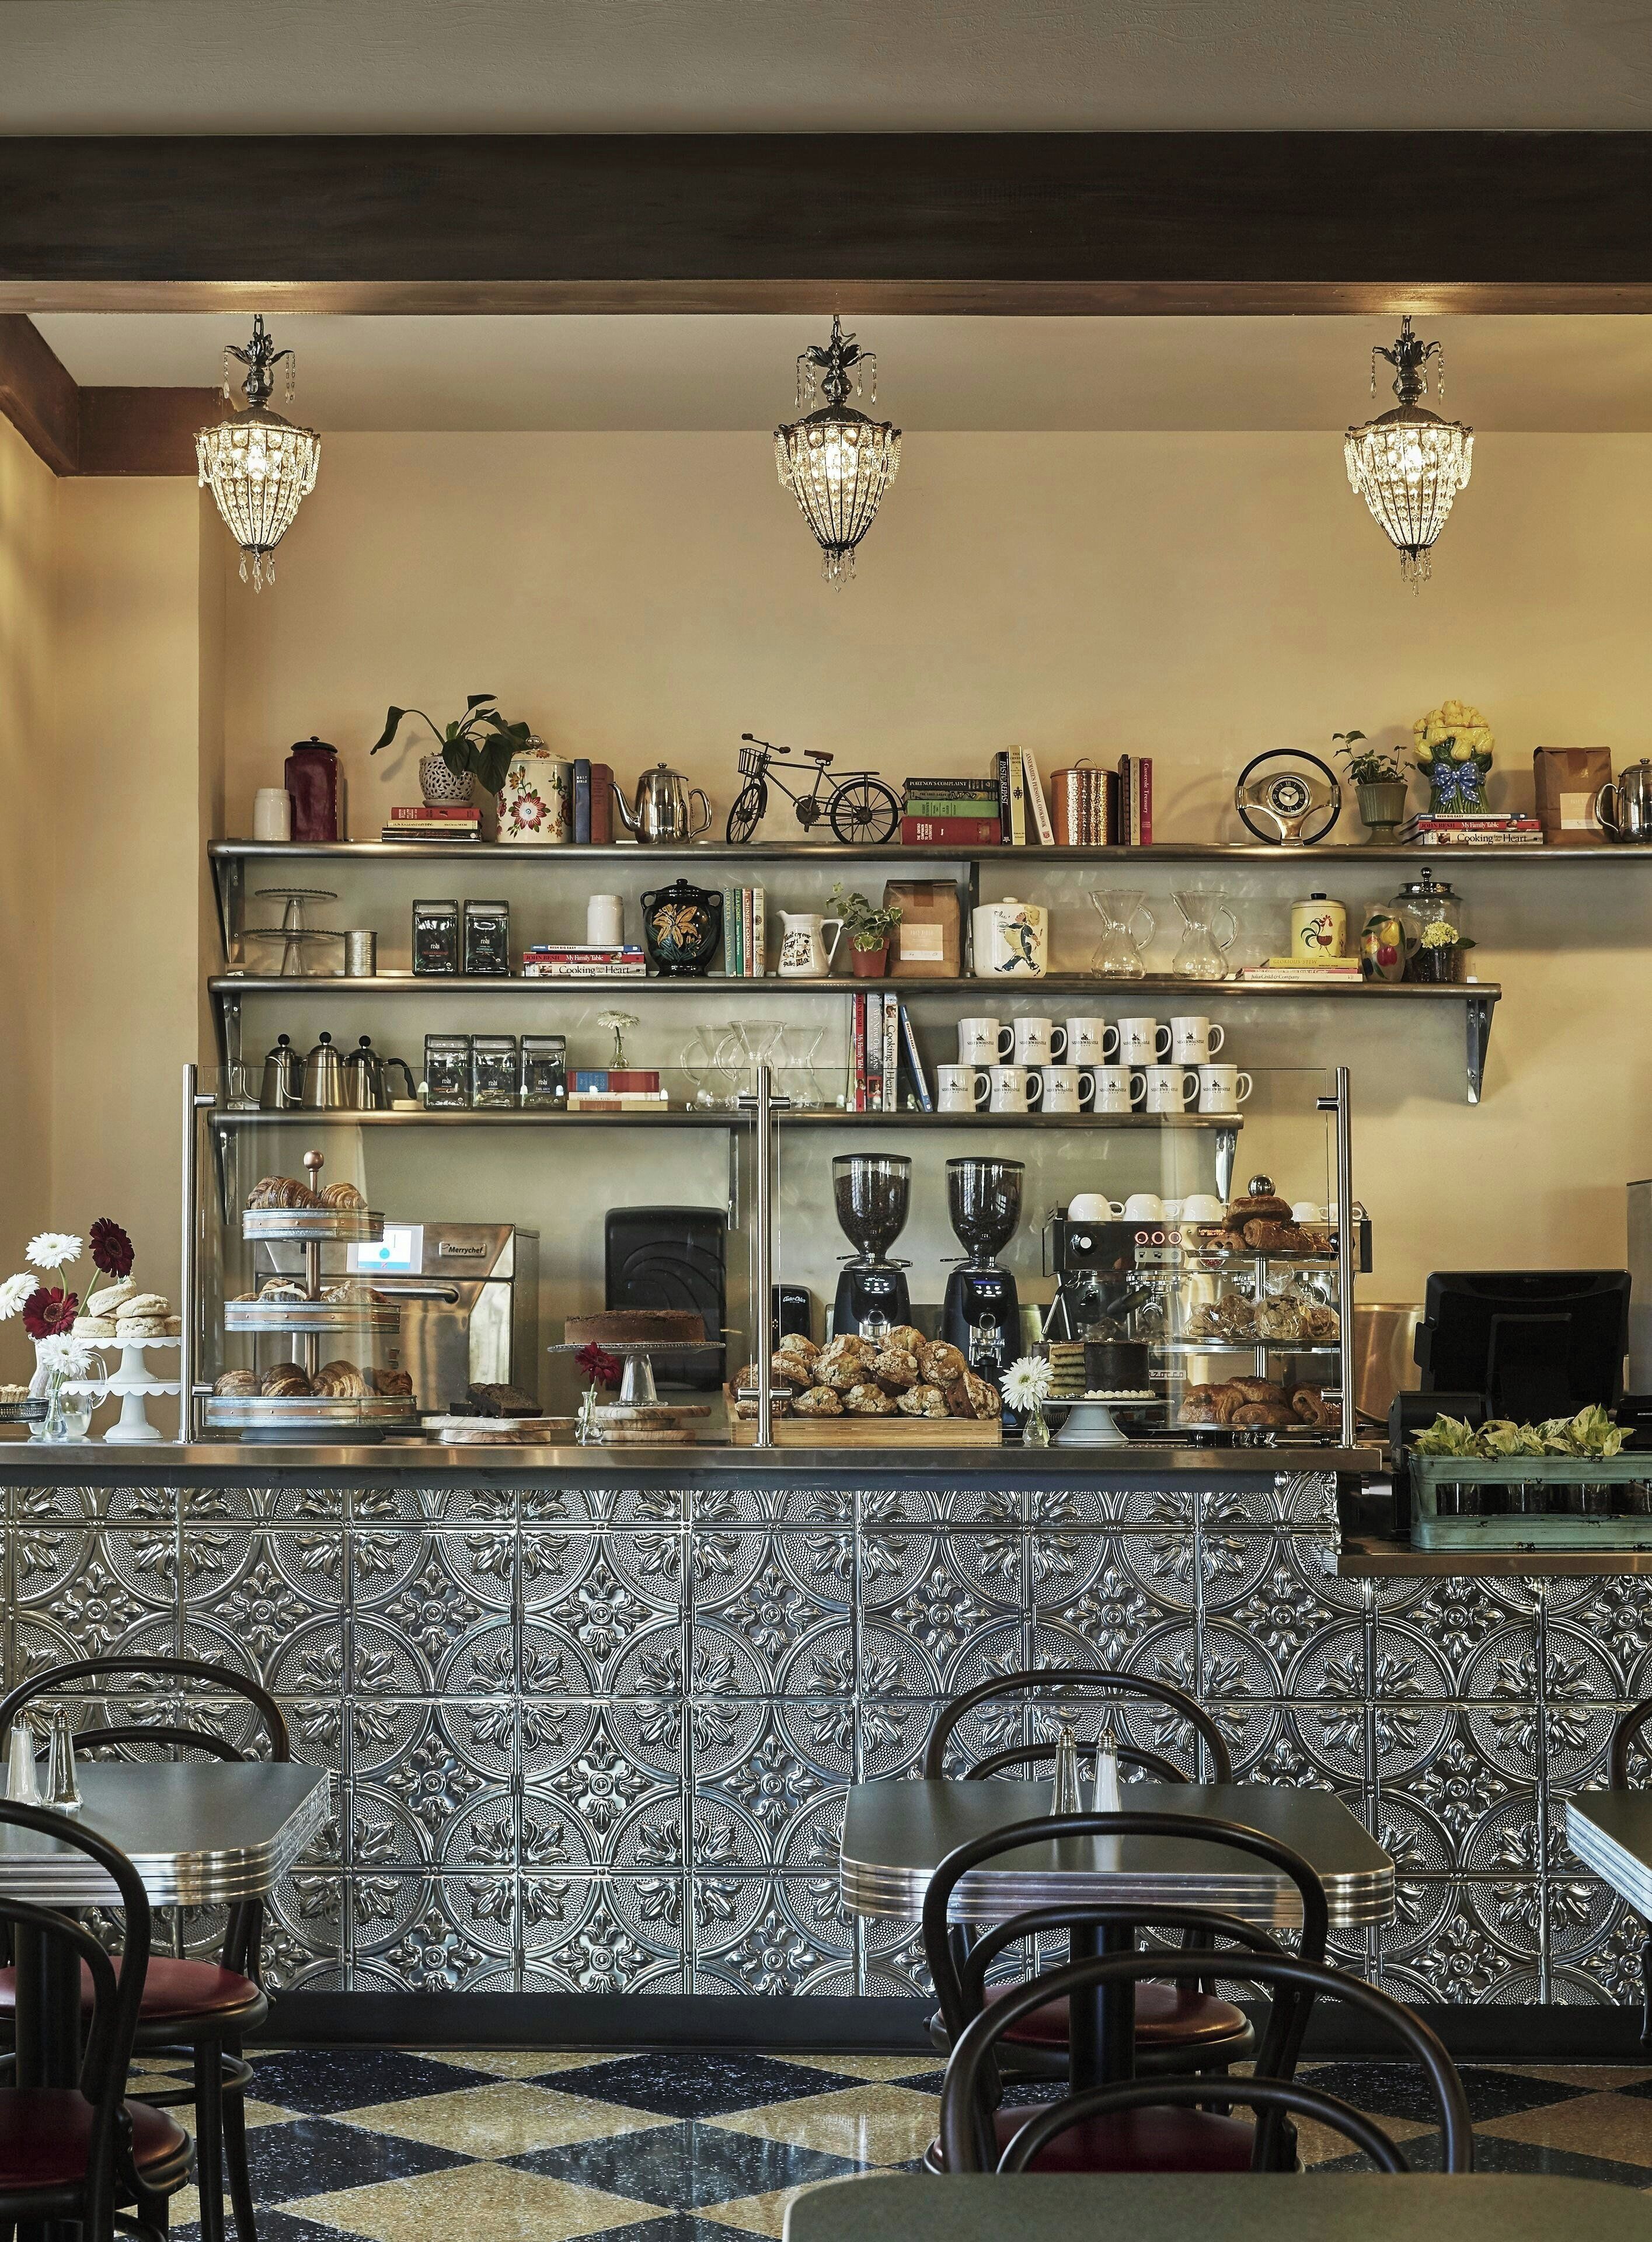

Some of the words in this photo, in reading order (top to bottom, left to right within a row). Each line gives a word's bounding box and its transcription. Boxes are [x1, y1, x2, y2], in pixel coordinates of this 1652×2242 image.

[1033, 781, 1041, 804] PERSONAL
[1037, 803, 1047, 827] COOKBOOK
[1457, 833, 1493, 844] Cooking
[559, 966, 595, 976] Cooking
[857, 1033, 863, 1042] My
[884, 1025, 895, 1061] Cooking
[886, 1071, 894, 1096] Heart
[448, 1246, 483, 1254] Merrychef
